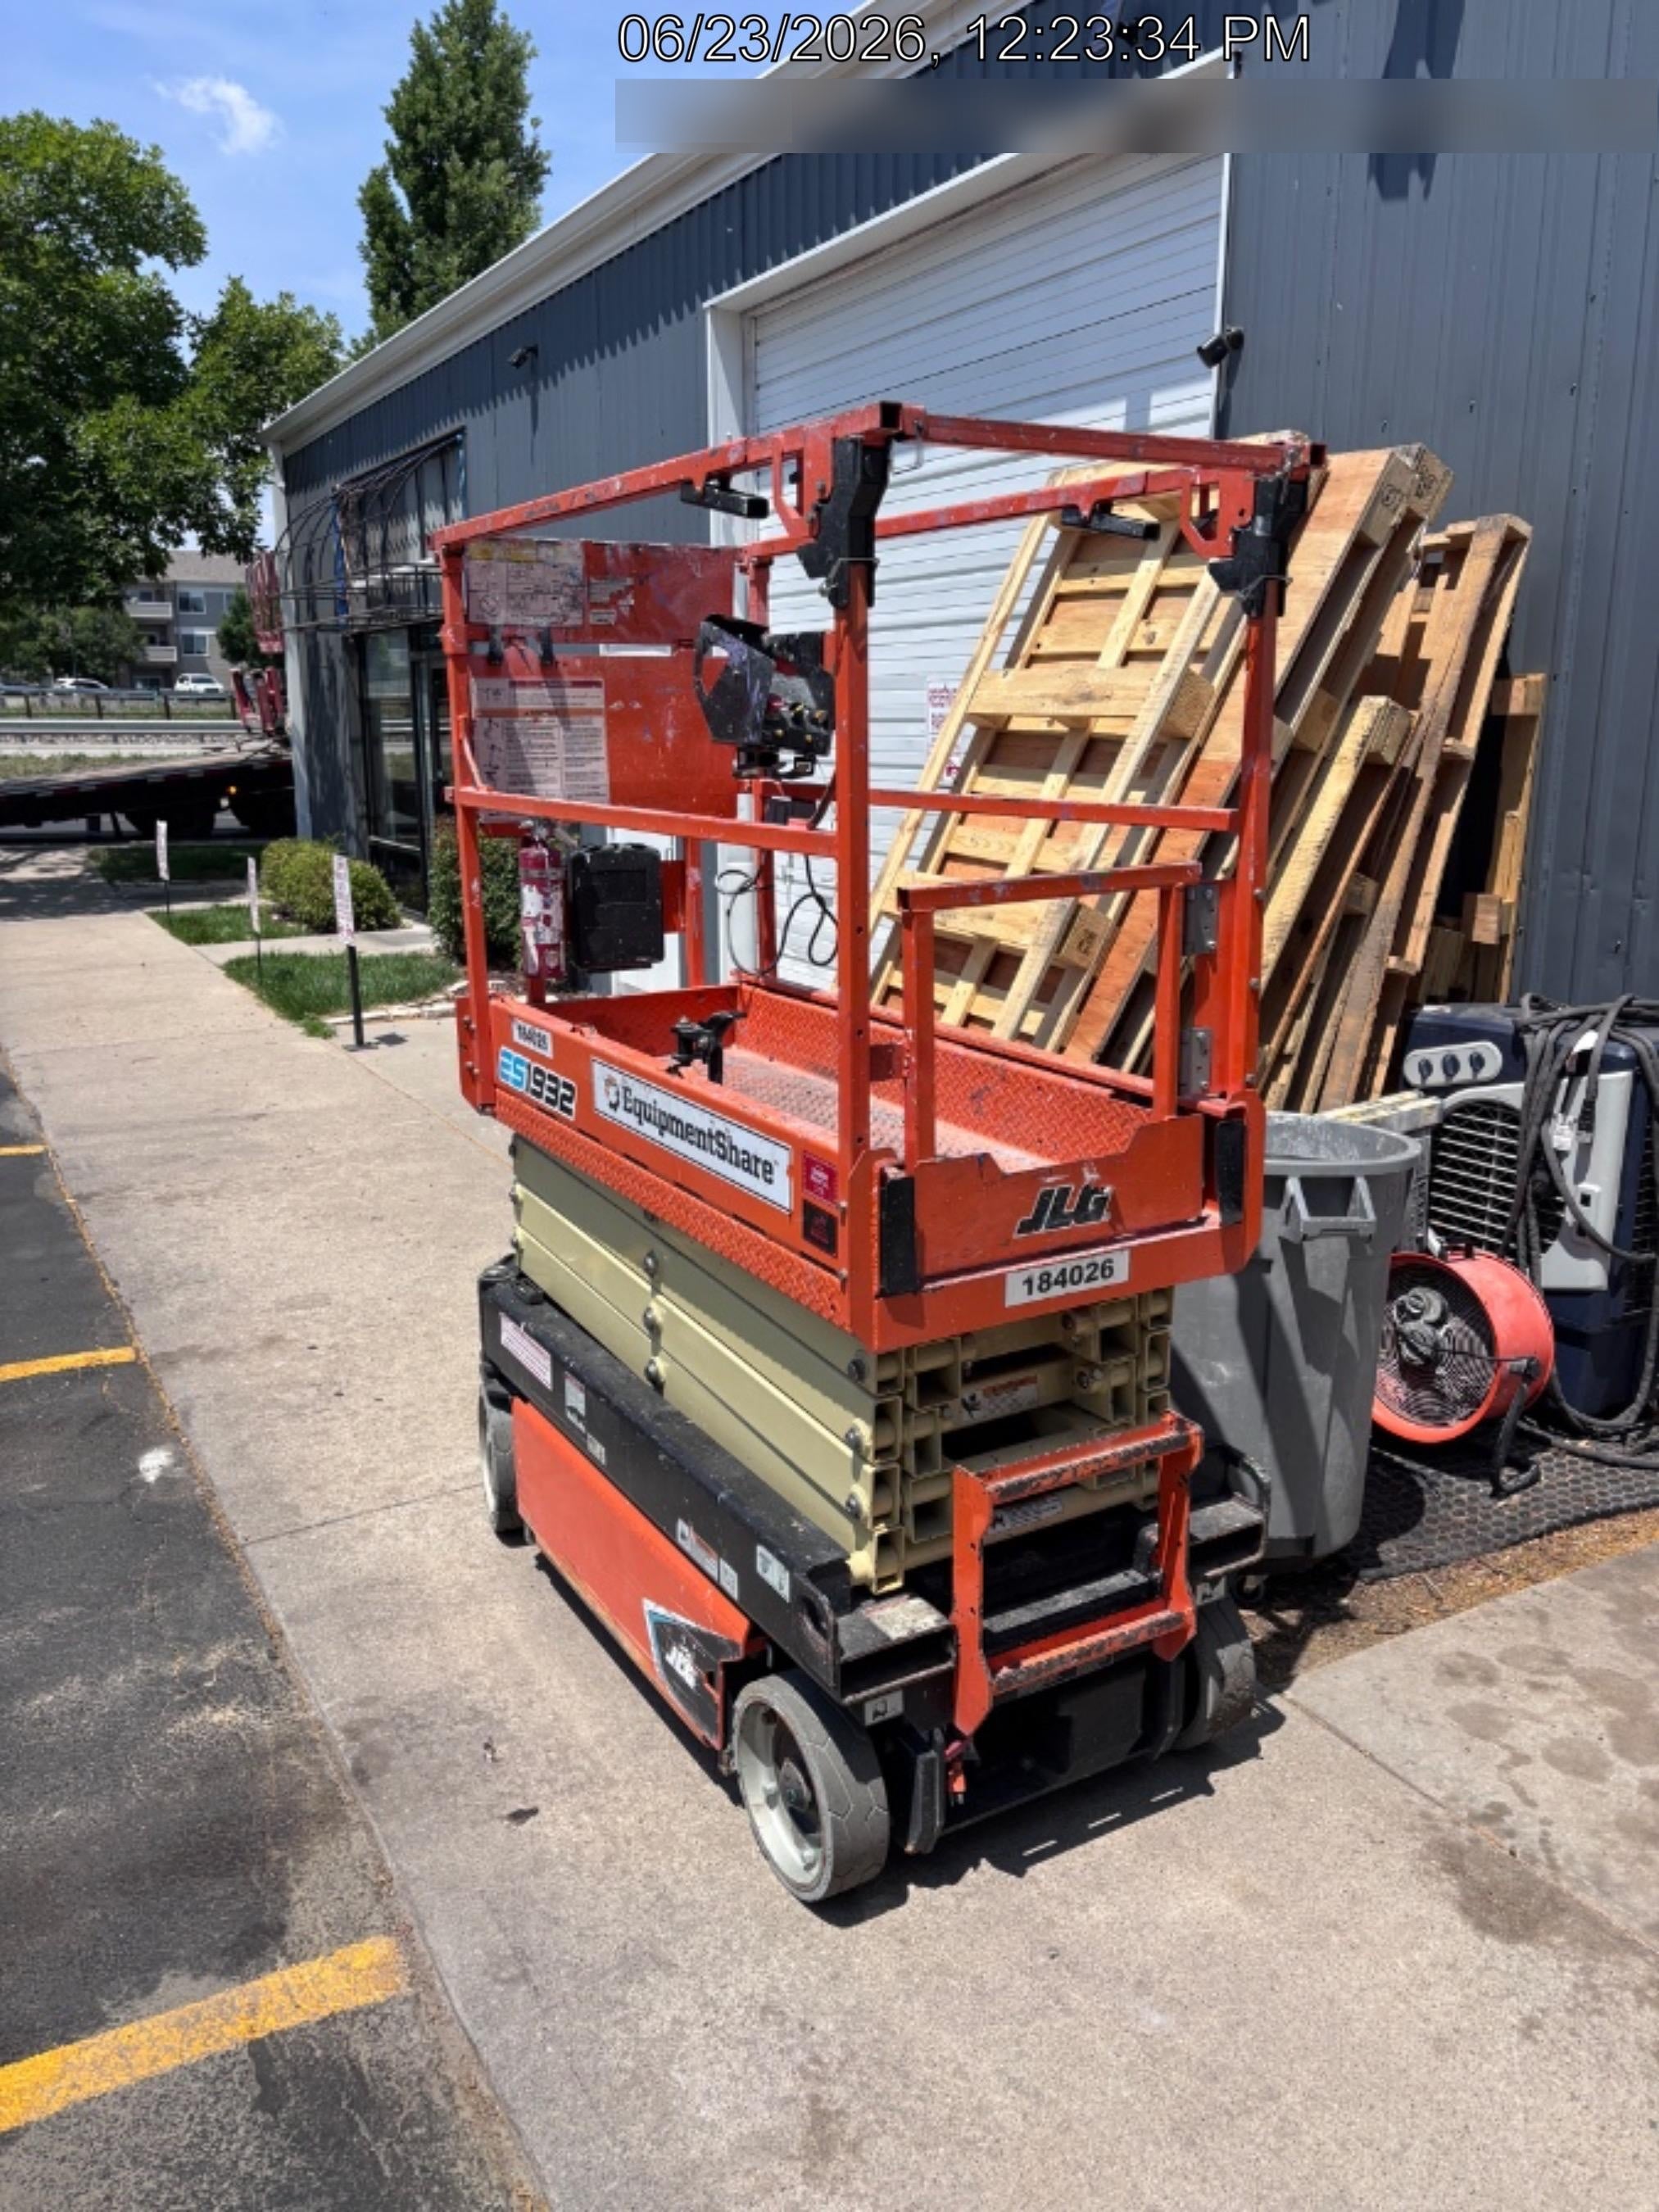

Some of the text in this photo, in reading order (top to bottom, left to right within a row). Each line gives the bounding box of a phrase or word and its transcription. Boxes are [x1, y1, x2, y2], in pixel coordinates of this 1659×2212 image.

[500, 1048, 576, 1117] ES1932
[620, 1085, 776, 1186] EquipmentShare
[1013, 1184, 1112, 1238] JLG
[1021, 1257, 1115, 1297] 184026
